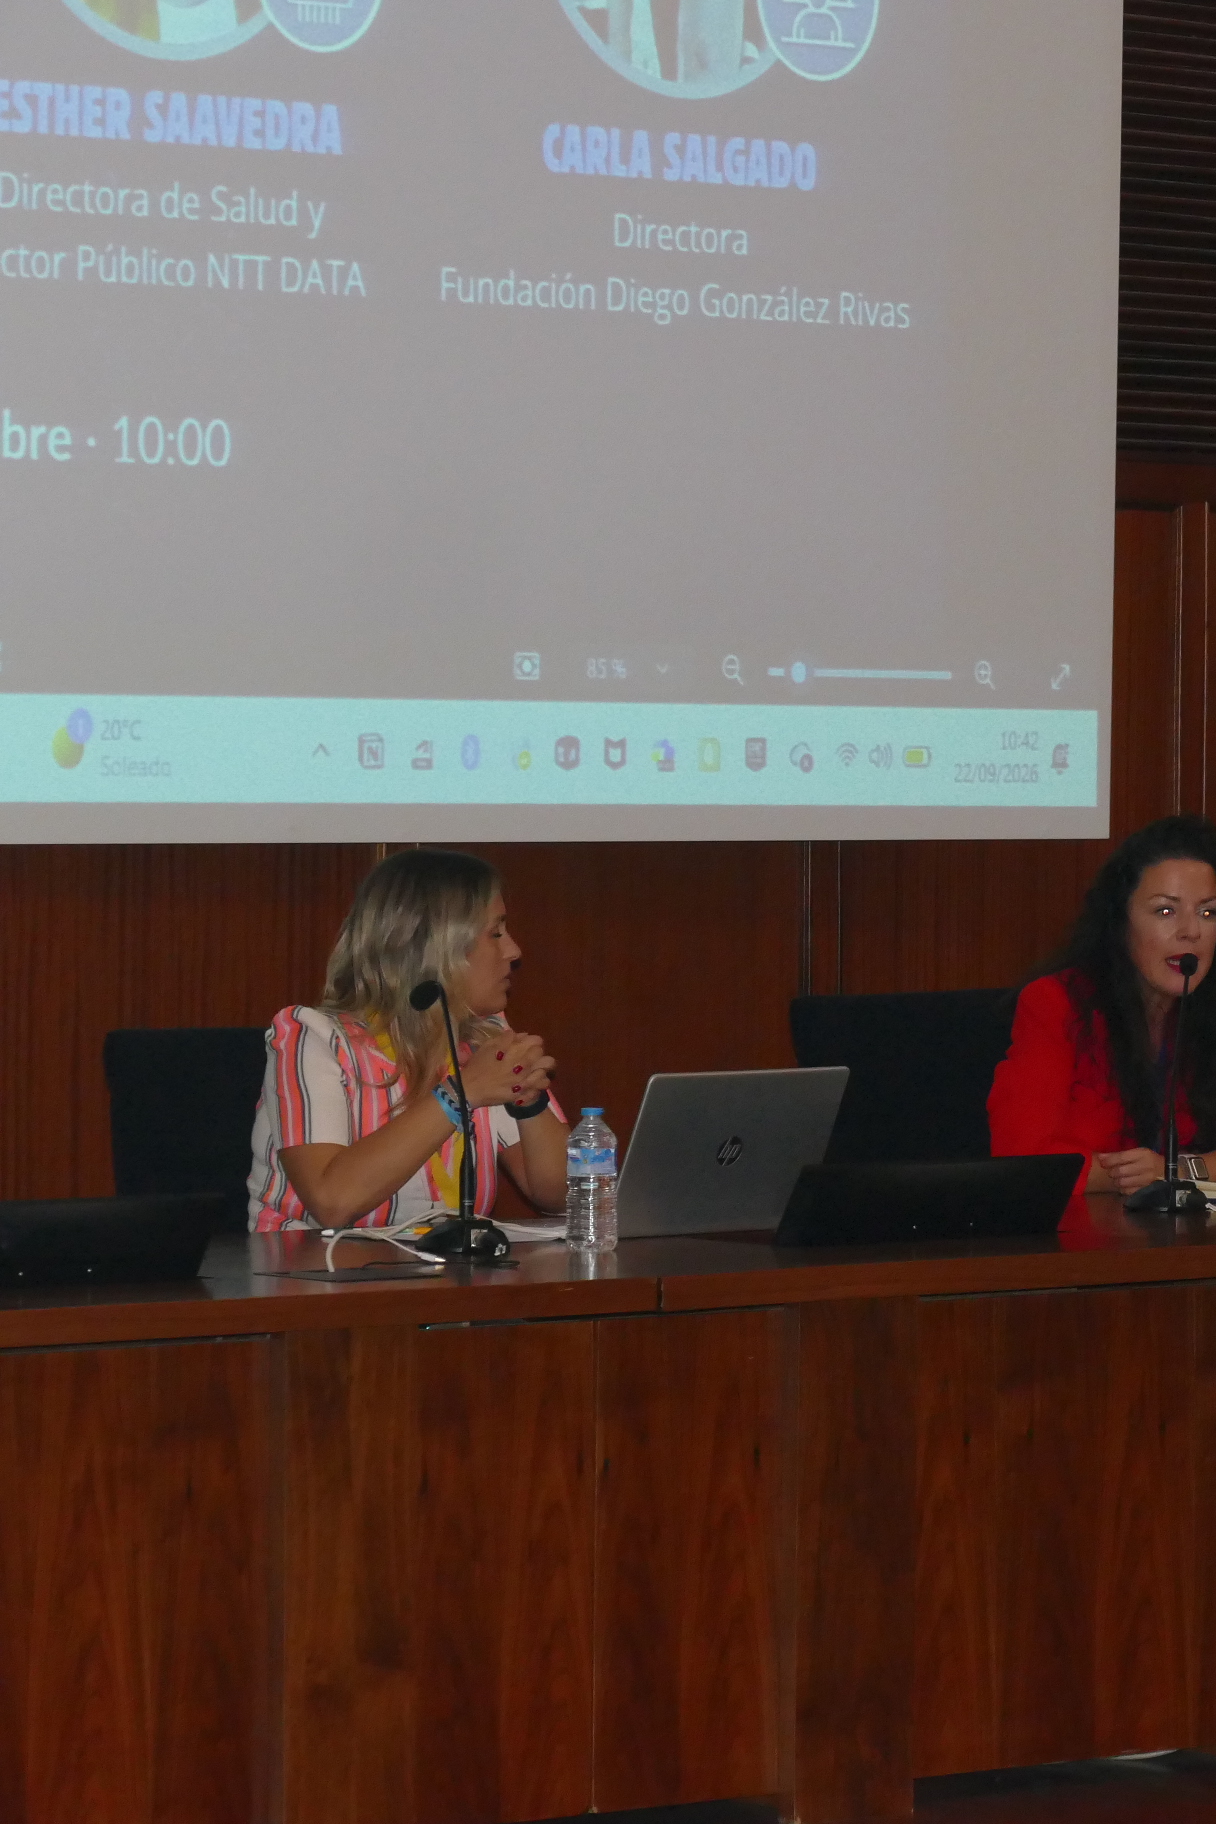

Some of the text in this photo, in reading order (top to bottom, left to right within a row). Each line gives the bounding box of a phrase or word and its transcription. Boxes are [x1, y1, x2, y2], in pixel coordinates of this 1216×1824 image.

[143, 91, 343, 154] SAAVEDRA
[542, 123, 818, 190] CARLA SALGADO
[0, 172, 326, 239] Directora de Salud y
[613, 213, 750, 256] Directora
[76, 243, 196, 287] Público
[207, 253, 271, 290] NTT
[280, 257, 367, 296] DATA
[440, 266, 911, 328] Fundación Diego González Rivas
[2, 409, 73, 461] bre
[115, 415, 233, 467] 10:00
[101, 719, 142, 741] 20°C
[1001, 730, 1039, 751] 10:42
[101, 754, 171, 777] Soleado
[953, 762, 1039, 784] 22/09/2026
